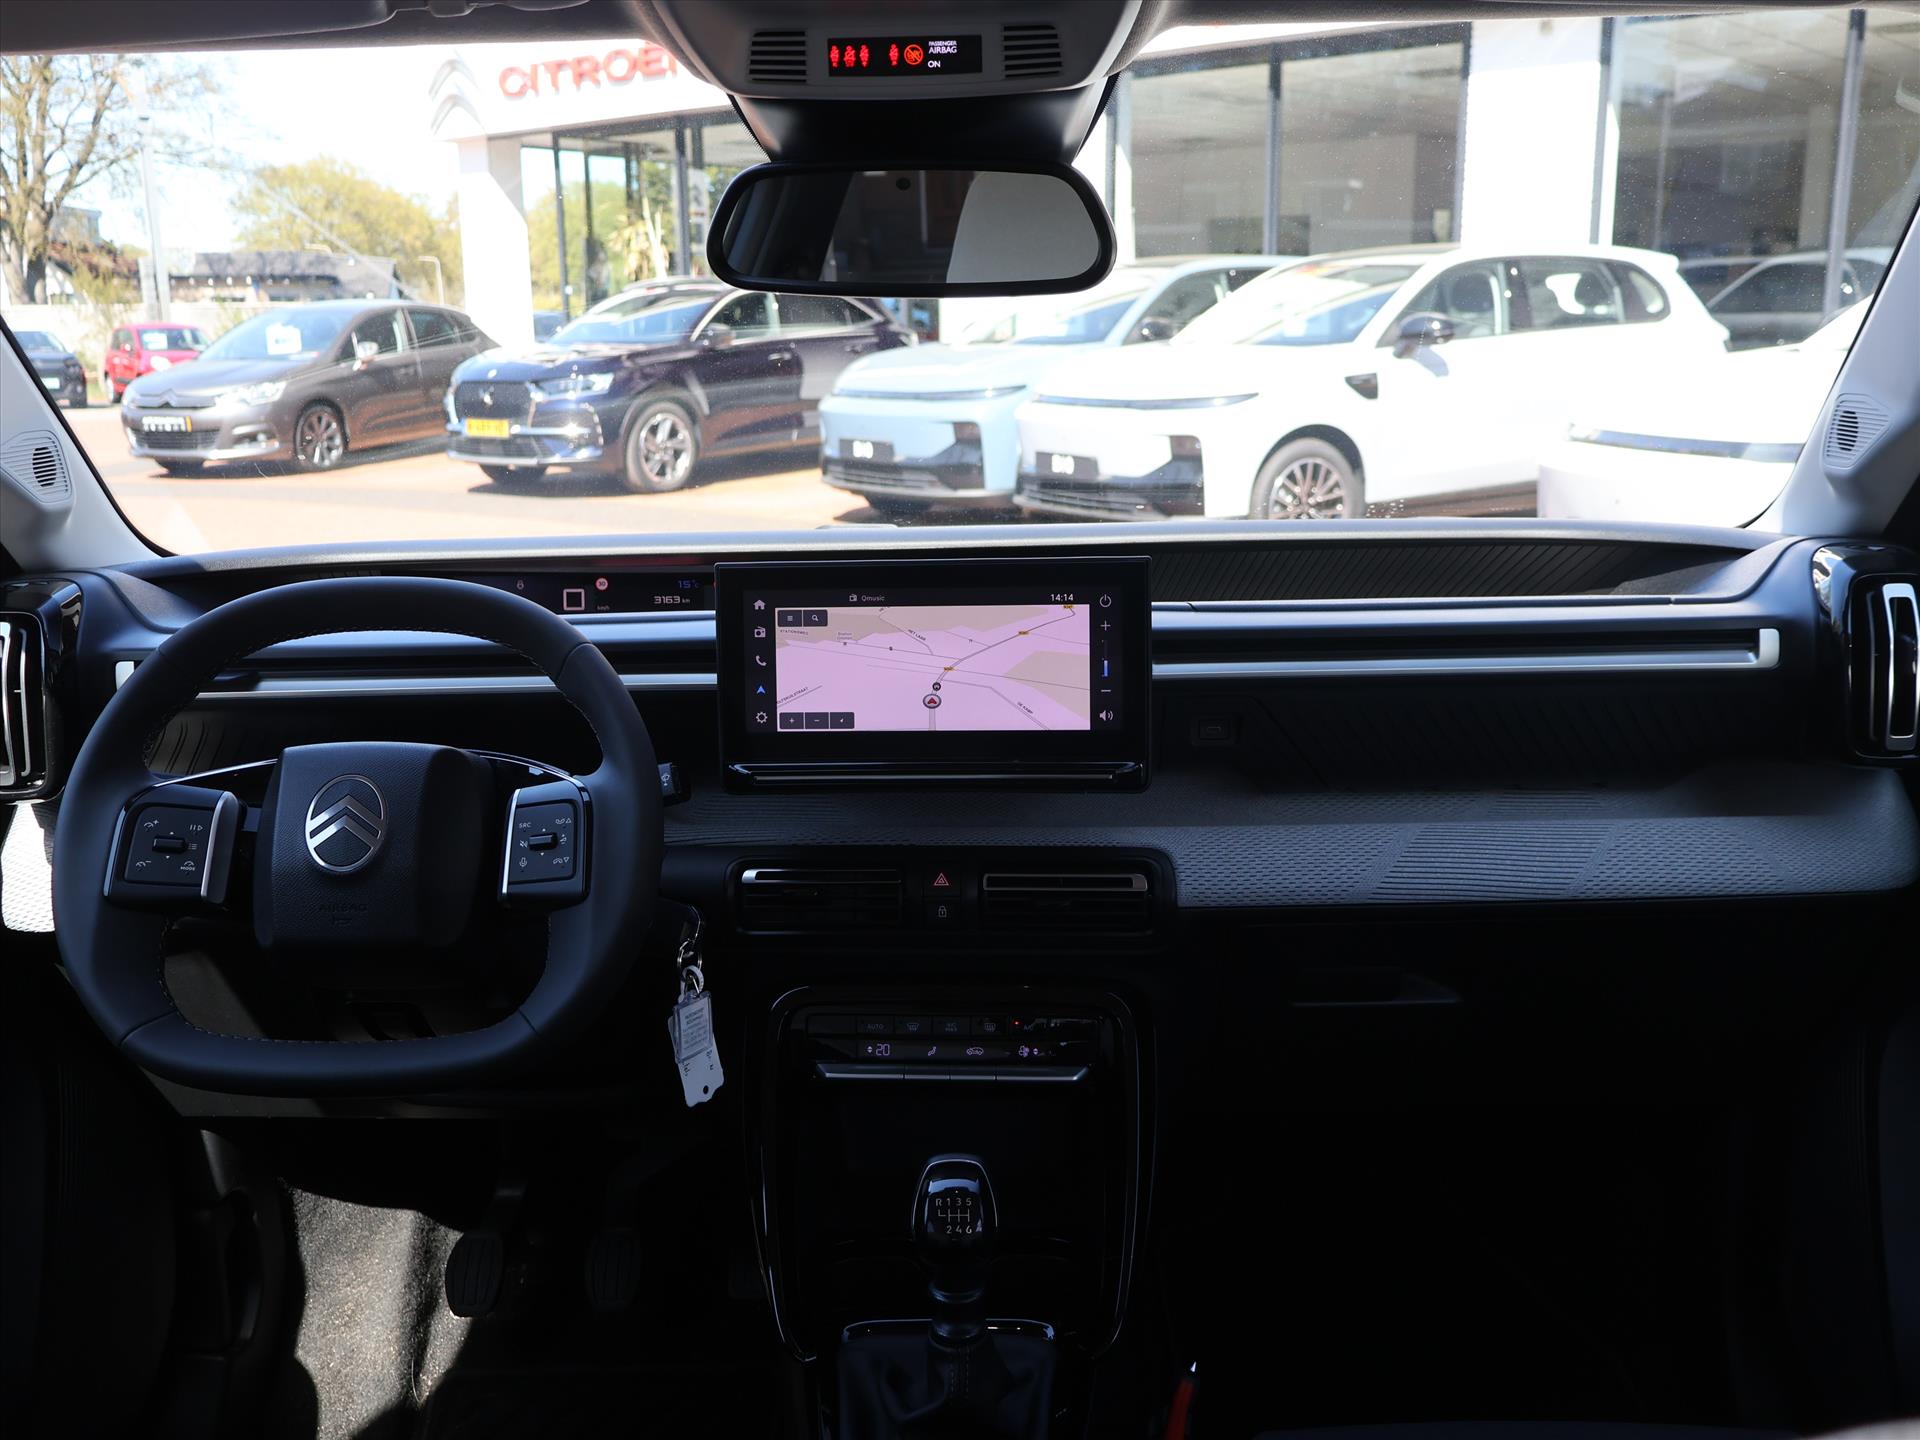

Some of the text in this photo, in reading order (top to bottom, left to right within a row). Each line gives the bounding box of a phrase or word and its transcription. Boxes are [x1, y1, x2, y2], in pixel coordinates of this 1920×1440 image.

[928, 46, 958, 54] AIRBAG
[928, 60, 941, 68] ON
[654, 595, 681, 604] 3163
[867, 1023, 884, 1031] AUTO
[876, 1044, 890, 1055] 20
[935, 1198, 942, 1206] R
[956, 1198, 962, 1206] 3
[965, 1198, 972, 1206] 5
[946, 1225, 972, 1234] 2 4 6
